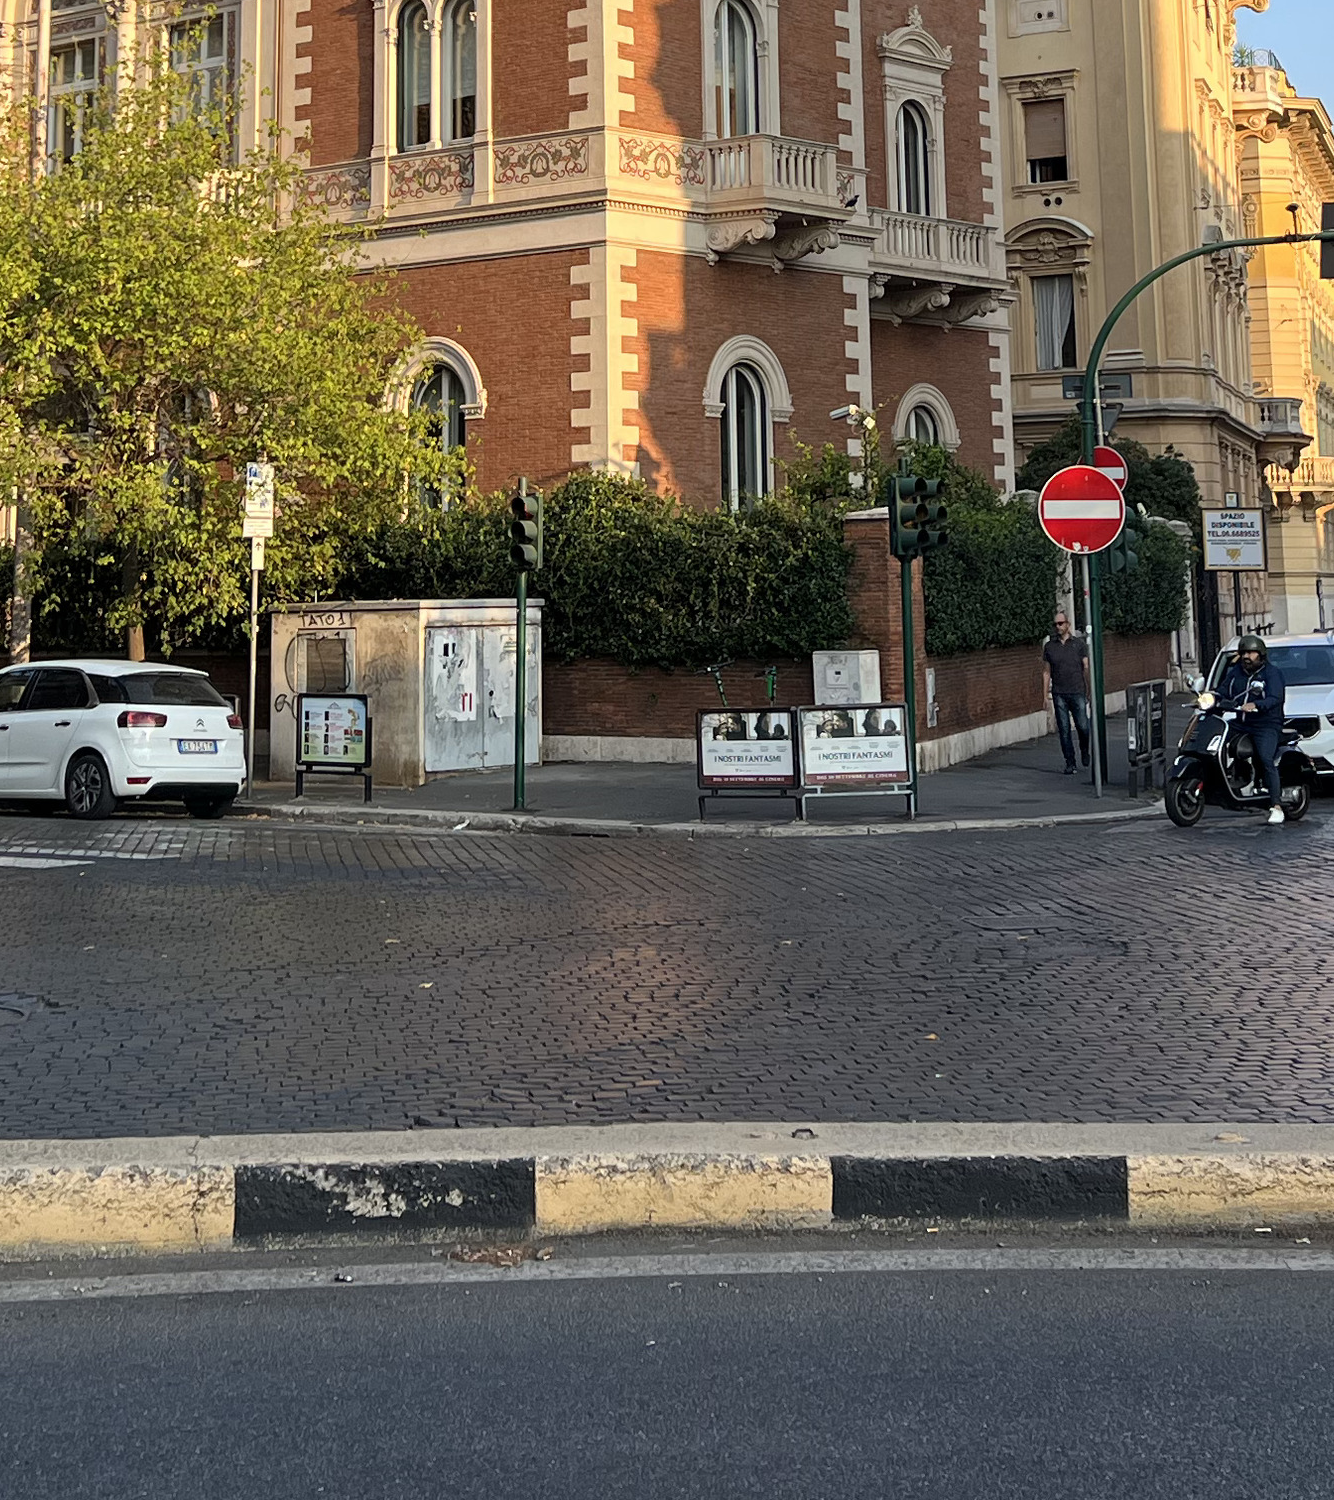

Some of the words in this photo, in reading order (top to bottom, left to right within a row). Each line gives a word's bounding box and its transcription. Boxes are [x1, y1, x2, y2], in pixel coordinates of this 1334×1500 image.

[1220, 512, 1245, 520] SPAZIO
[1211, 521, 1255, 529] DISPONIBILE
[718, 755, 744, 763] NOSTRI
[745, 755, 782, 763] FANTASMI
[822, 752, 851, 760] NOSTRI
[852, 750, 893, 759] FANTASMI
